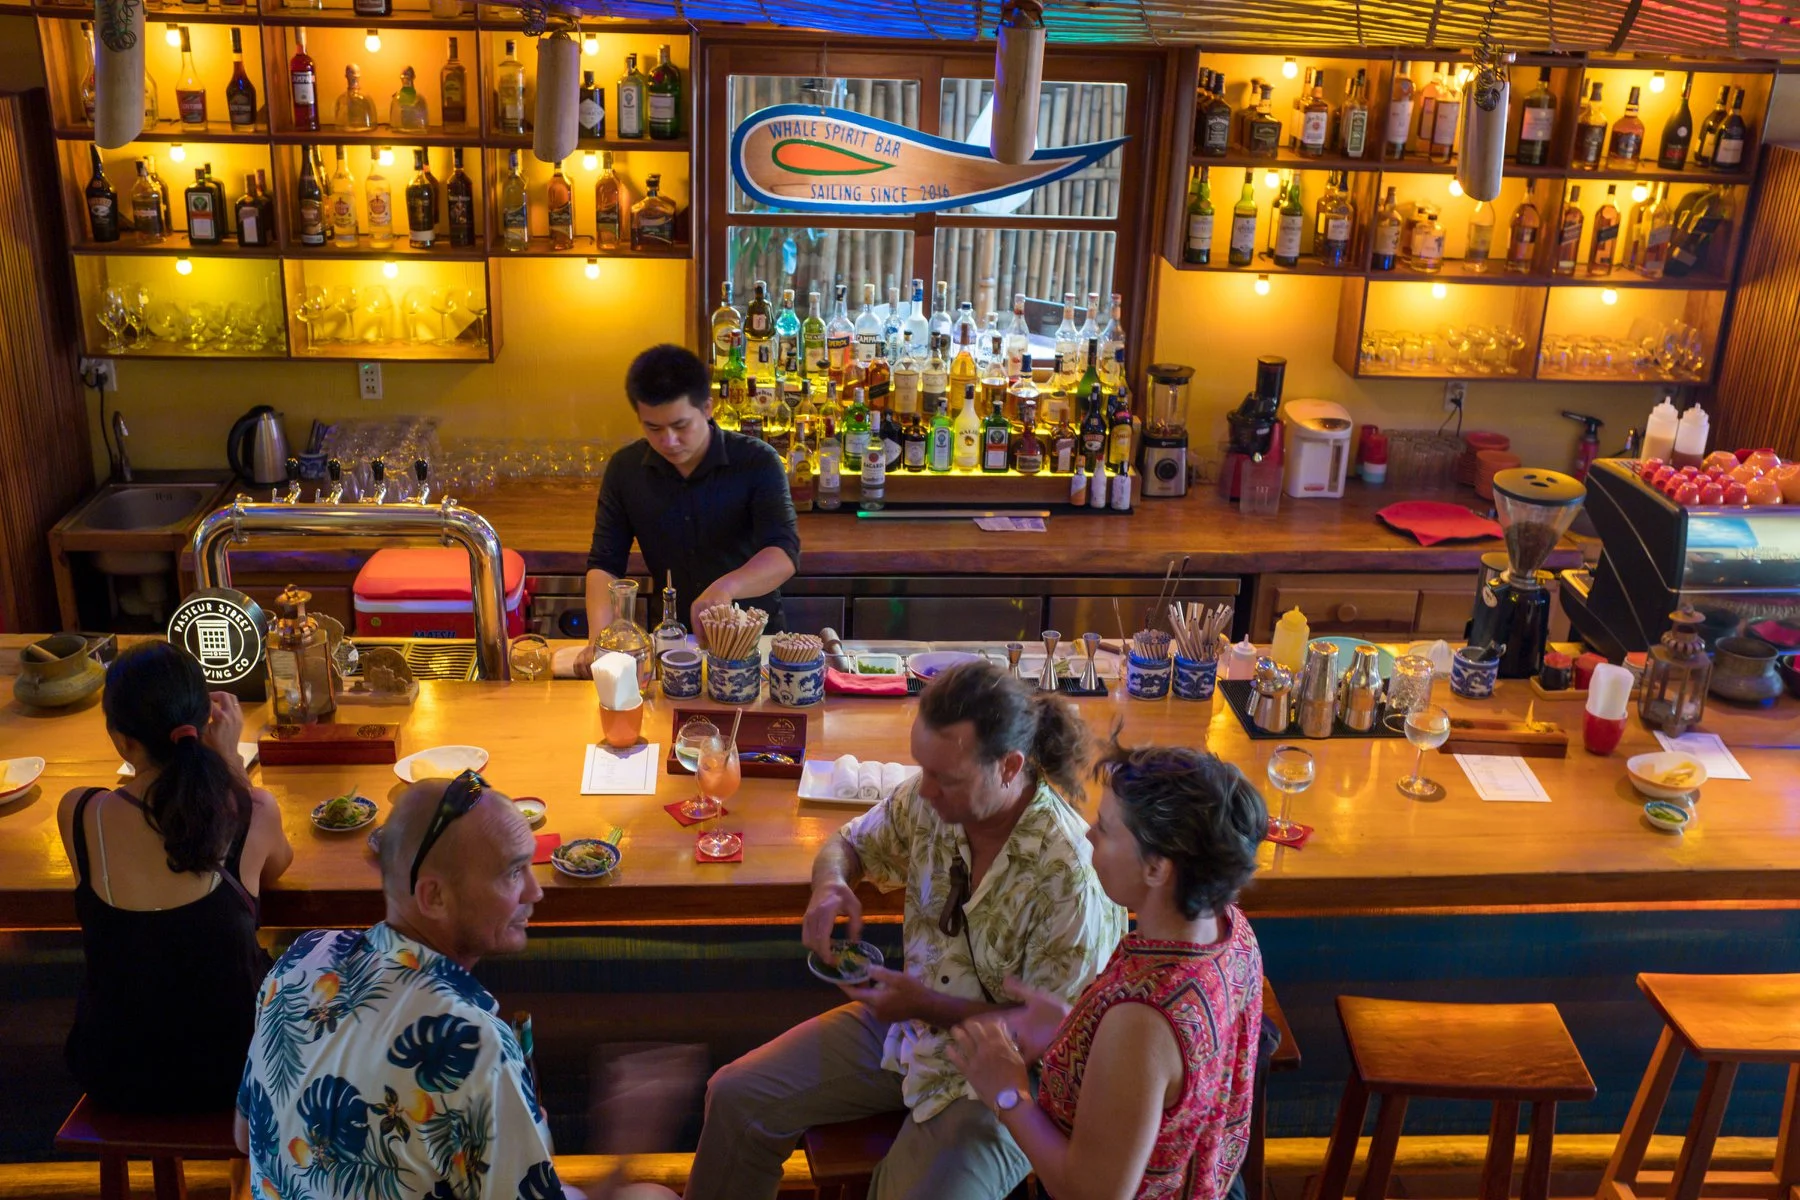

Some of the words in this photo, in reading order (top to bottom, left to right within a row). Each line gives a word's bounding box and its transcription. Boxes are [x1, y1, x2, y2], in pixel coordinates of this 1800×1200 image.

[768, 121, 817, 140] WHALE
[825, 123, 869, 148] SPIRIT
[875, 137, 901, 158] BAR
[810, 184, 862, 202] SAILING
[870, 186, 908, 204] SINCE
[920, 182, 950, 202] 2016
[174, 603, 212, 632] PASTEUR
[218, 604, 252, 632] STREET
[235, 658, 249, 672] CO
